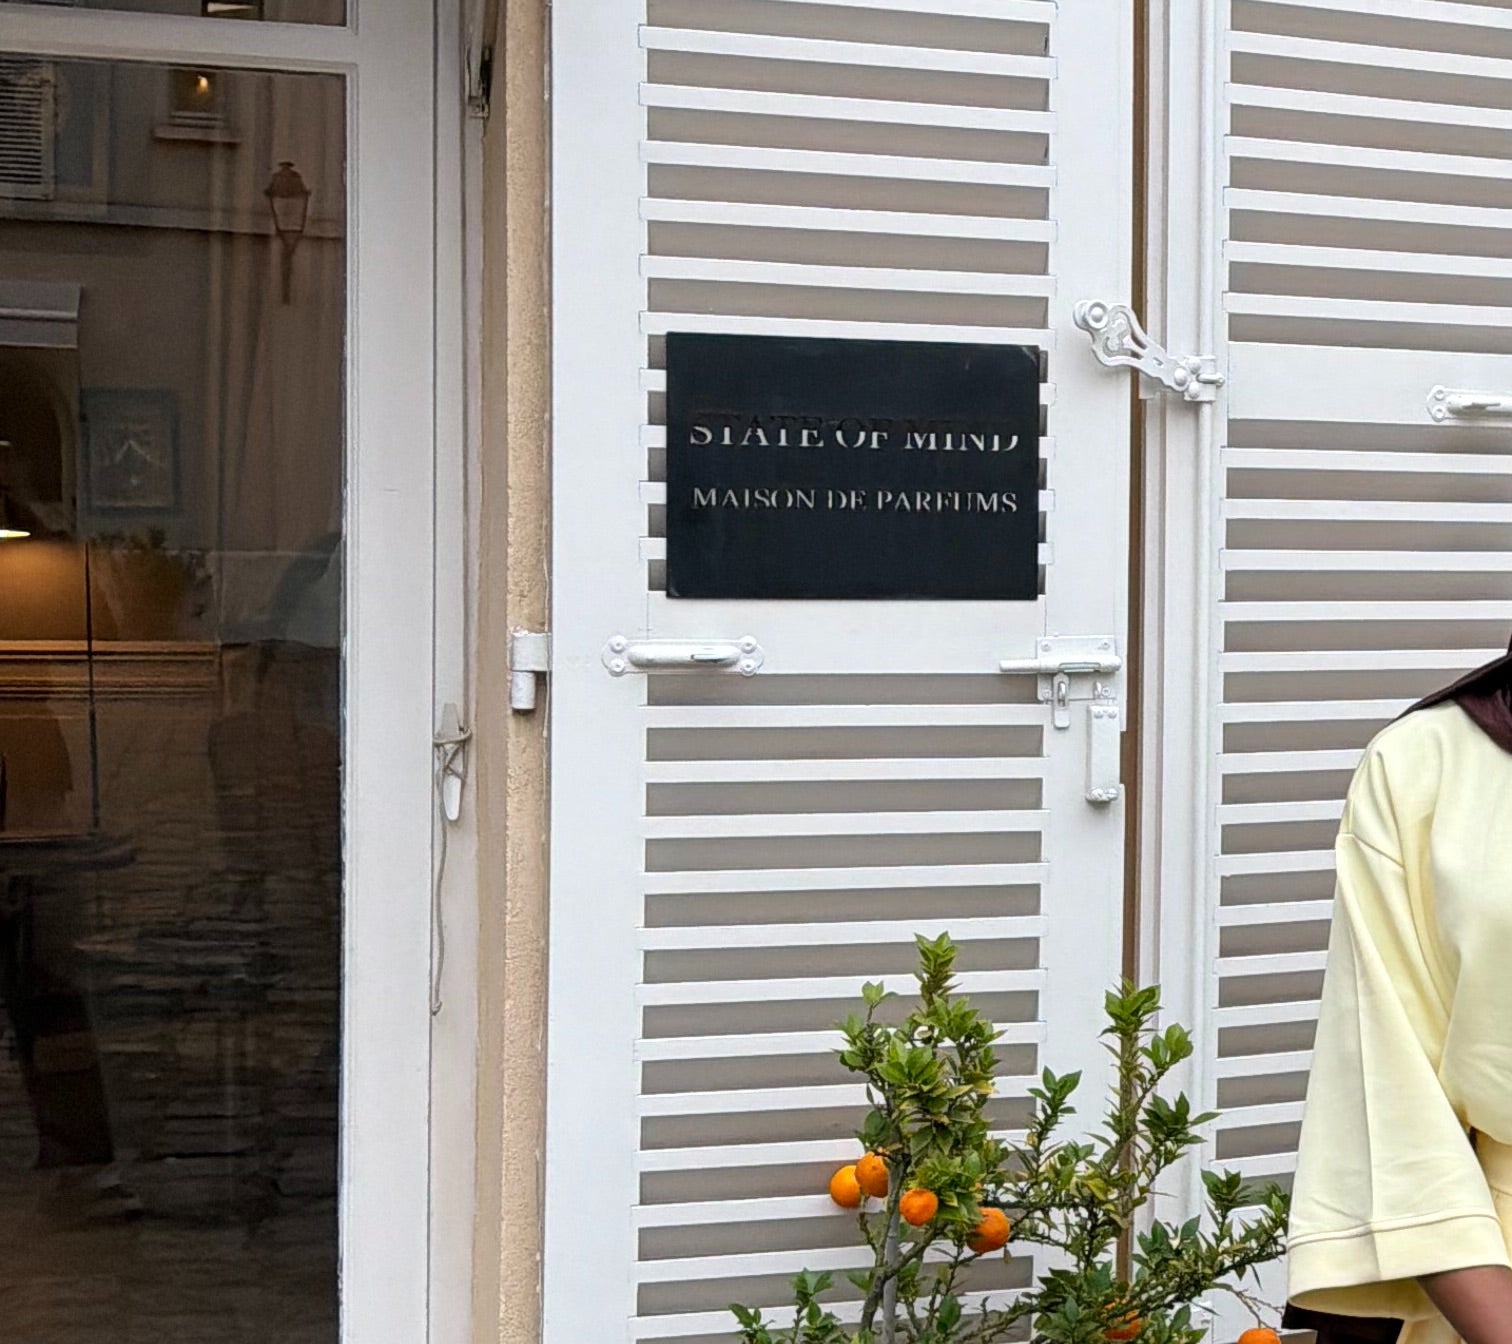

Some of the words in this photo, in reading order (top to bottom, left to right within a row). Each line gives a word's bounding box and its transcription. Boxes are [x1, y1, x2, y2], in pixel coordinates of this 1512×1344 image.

[689, 414, 825, 448] STATE
[834, 416, 889, 449] OF
[903, 419, 1020, 453] MIND
[692, 487, 816, 510] MAISON
[827, 490, 867, 511] DE
[876, 491, 1019, 514] PARFUMS
